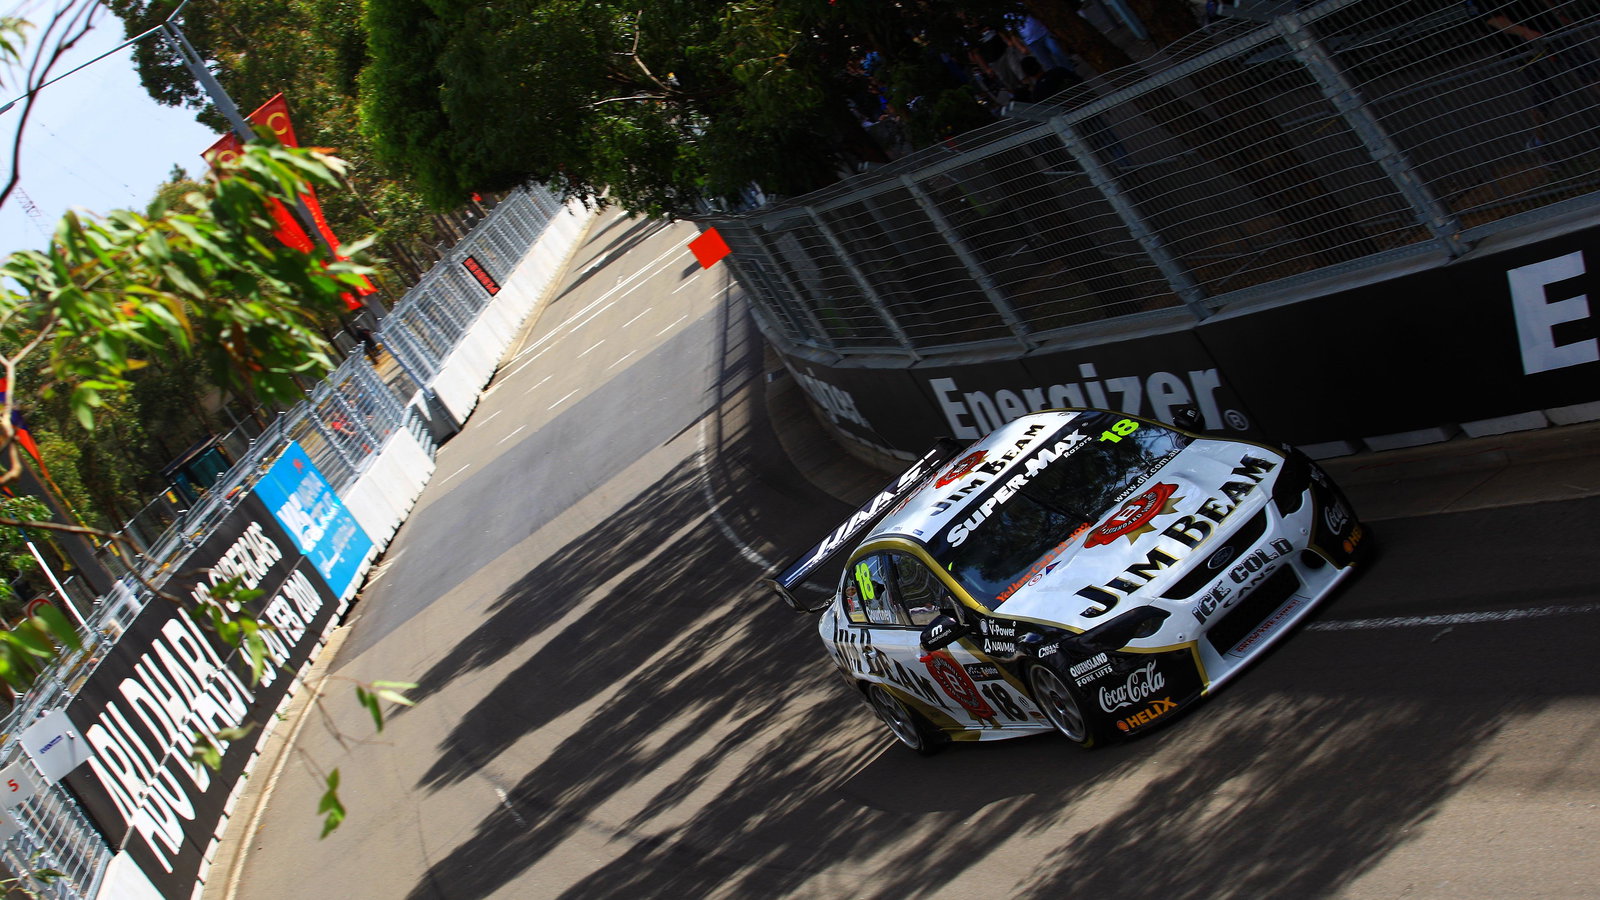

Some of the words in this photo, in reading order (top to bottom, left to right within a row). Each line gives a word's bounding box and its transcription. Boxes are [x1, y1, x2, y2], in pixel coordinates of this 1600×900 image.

[1064, 435, 1094, 459] Razors
[1099, 418, 1140, 445] 18
[931, 475, 985, 517] JIM
[978, 423, 1046, 477] BEAM
[947, 428, 1089, 548] SUPER-MAX
[1113, 447, 1181, 503] www.djr.com.au
[1113, 503, 1142, 522] B
[1072, 543, 1182, 620] JIM
[1171, 453, 1278, 552] BEAM
[282, 569, 324, 624] 2010
[855, 563, 875, 600] 18
[996, 572, 1032, 602] Yellow
[1192, 579, 1232, 625] ICE
[1228, 537, 1293, 585] COLD
[1223, 564, 1277, 609] CANS
[265, 595, 307, 648] FEB
[989, 623, 1016, 637] V-Power
[1069, 652, 1109, 678] QUEENSLAND
[1076, 674, 1097, 688] FORK
[1095, 665, 1113, 679] LIFTS
[118, 607, 255, 793] DHABI
[982, 682, 1029, 722] 18
[1125, 696, 1180, 728] HELIX
[8, 778, 20, 793] 5
[87, 701, 196, 873] ABU
